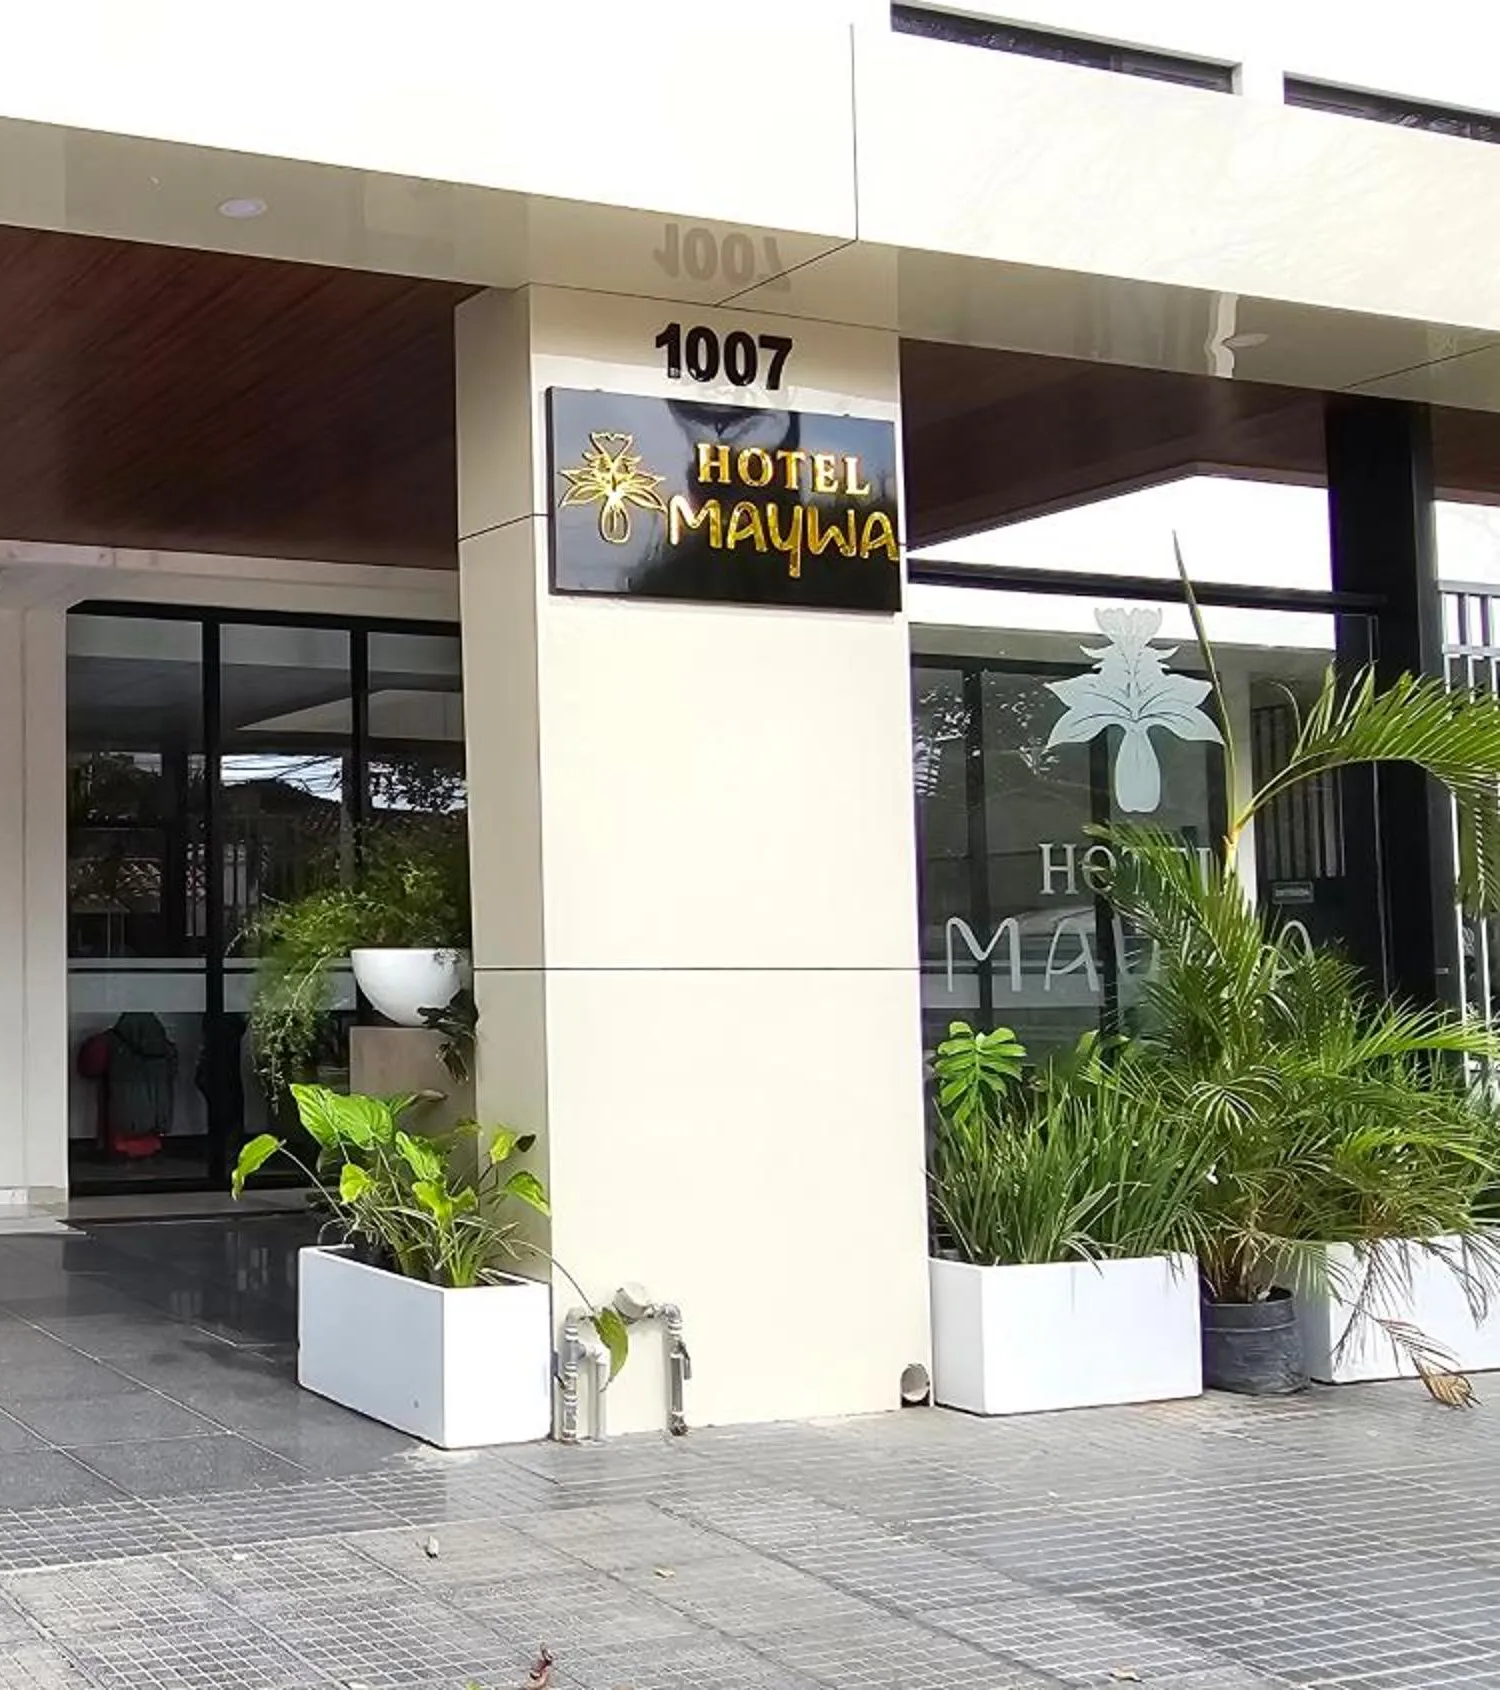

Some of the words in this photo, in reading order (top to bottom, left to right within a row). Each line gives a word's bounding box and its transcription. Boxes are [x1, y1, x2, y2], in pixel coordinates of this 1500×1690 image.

[655, 322, 793, 391] 1007
[697, 443, 871, 495] HOTEL
[669, 494, 900, 578] MAYWA
